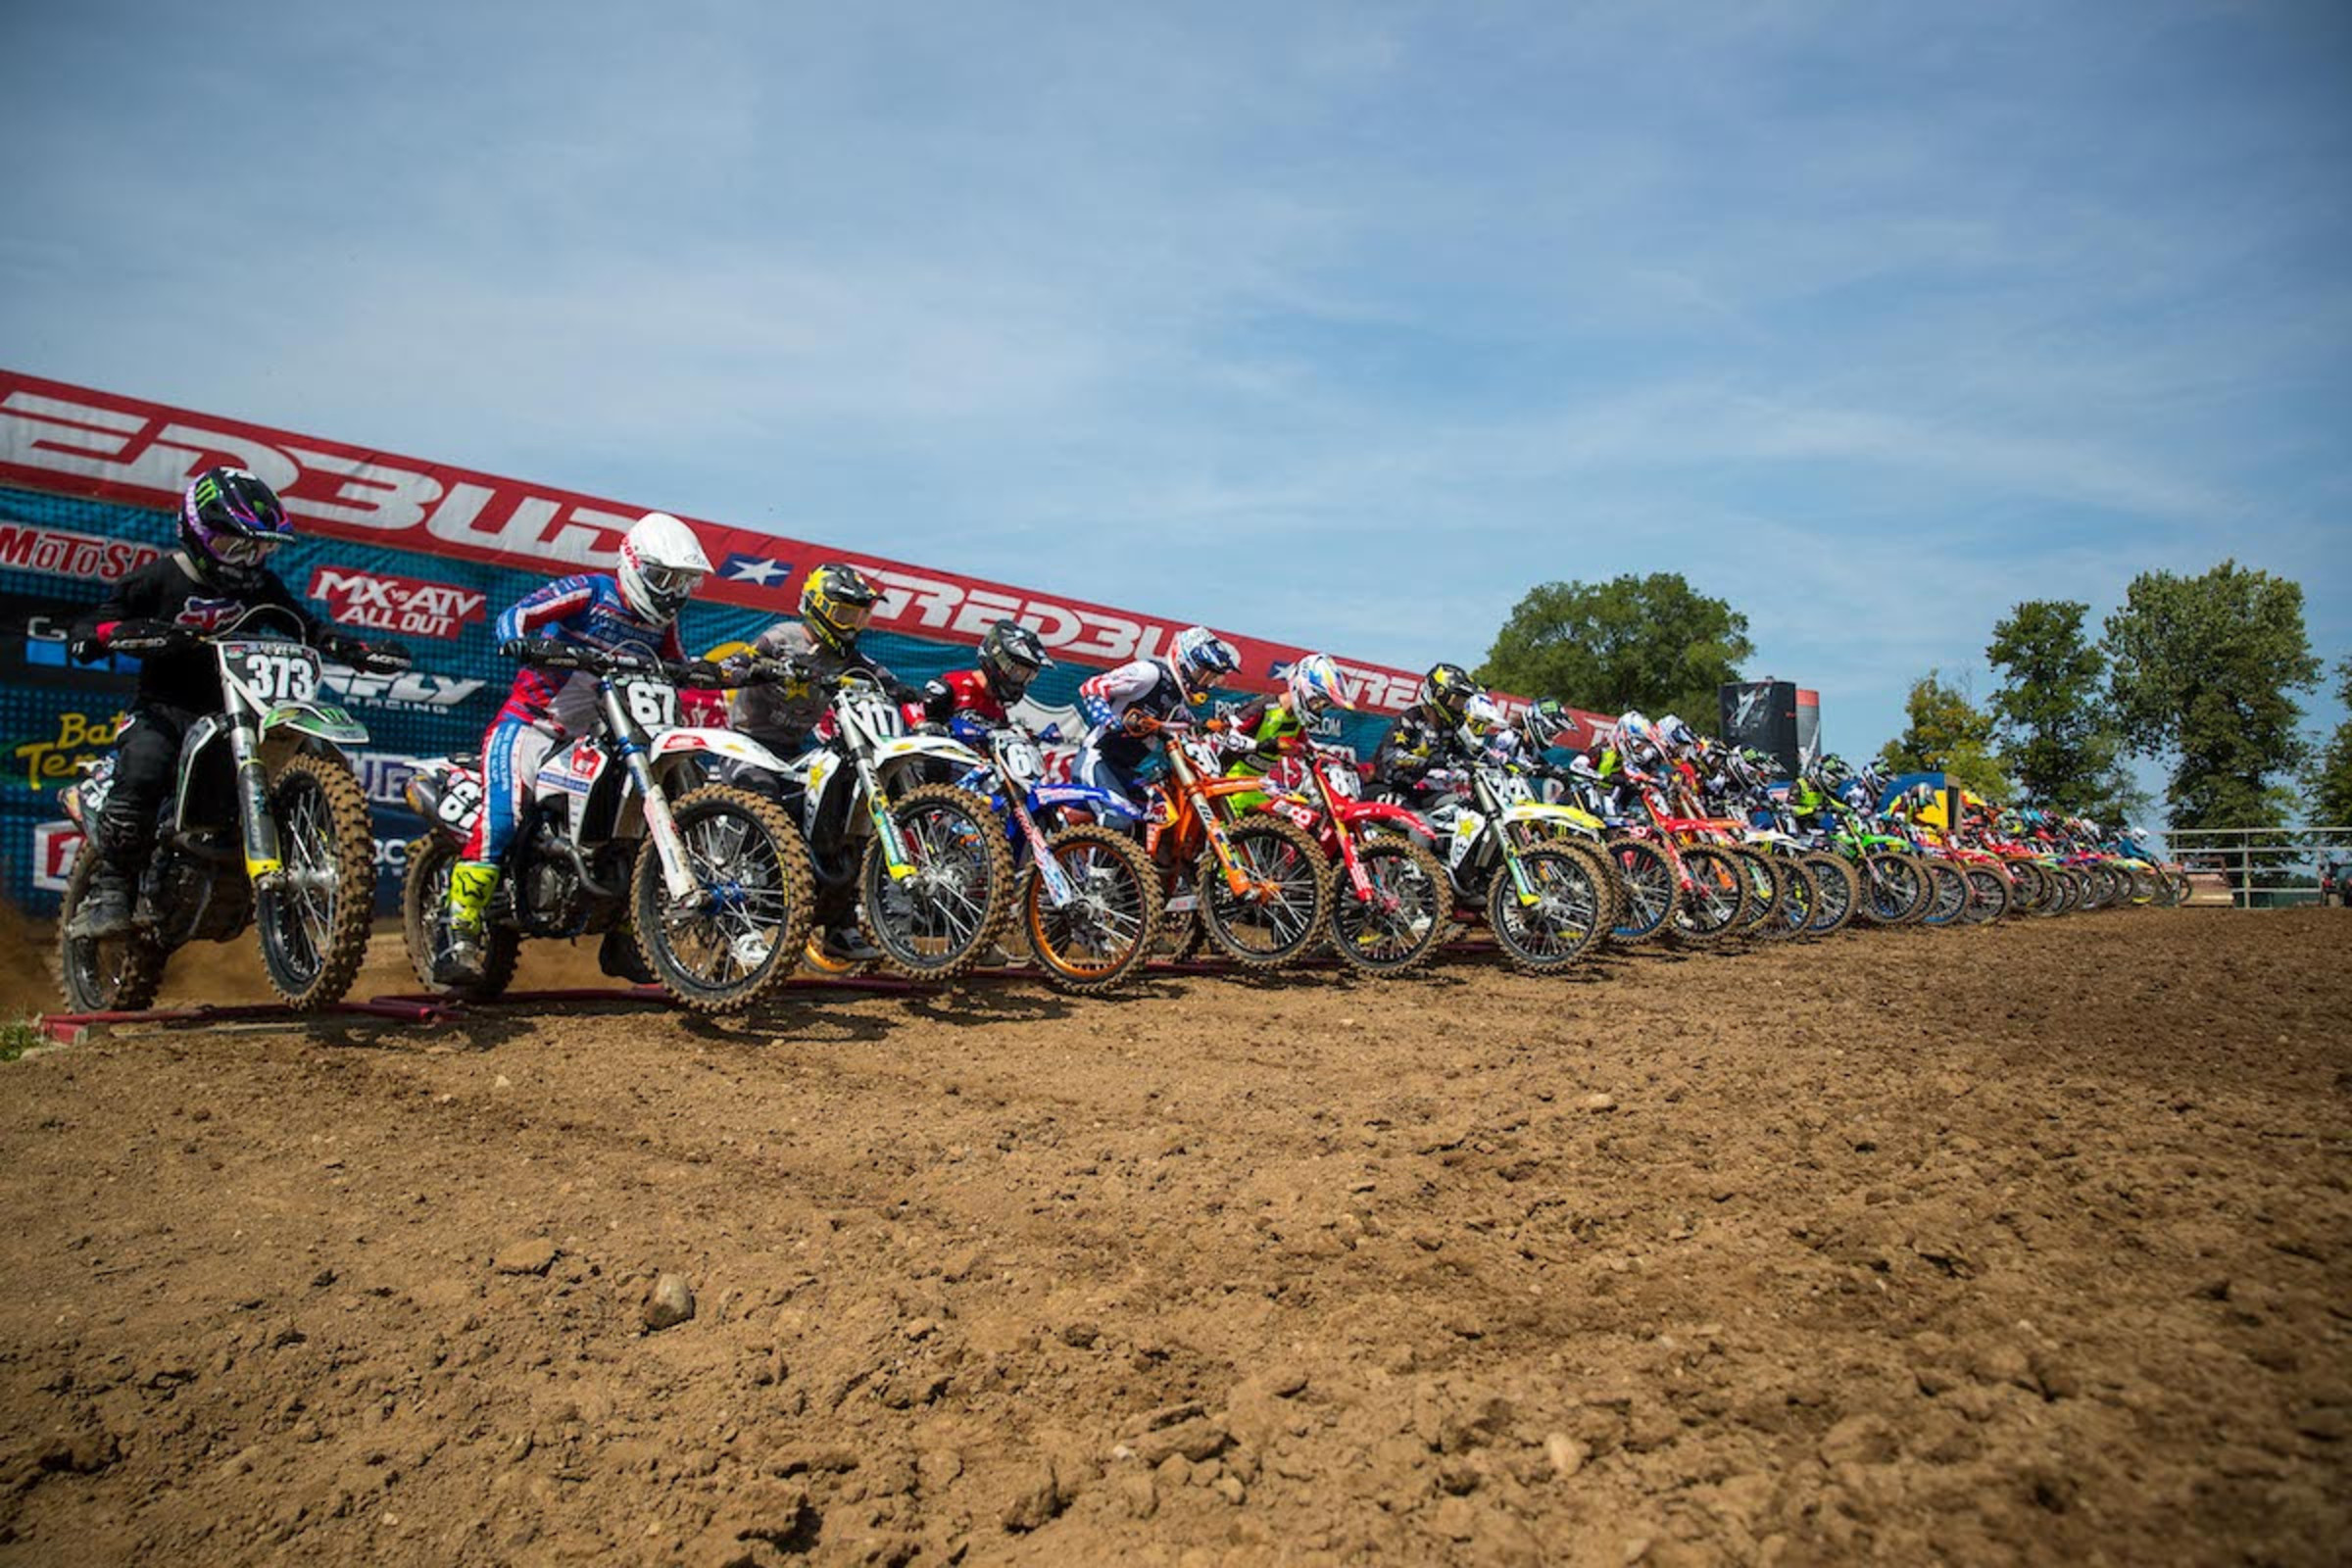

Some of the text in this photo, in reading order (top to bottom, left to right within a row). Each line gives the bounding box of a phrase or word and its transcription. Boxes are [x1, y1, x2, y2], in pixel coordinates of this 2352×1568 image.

[311, 570, 399, 609] MX
[398, 586, 487, 617] ATV
[335, 606, 455, 636] ALL OUT
[846, 564, 1242, 670] REDBU
[246, 654, 315, 702] 373
[321, 662, 487, 705] FLY
[344, 696, 449, 714] RACING
[627, 681, 676, 725] 67
